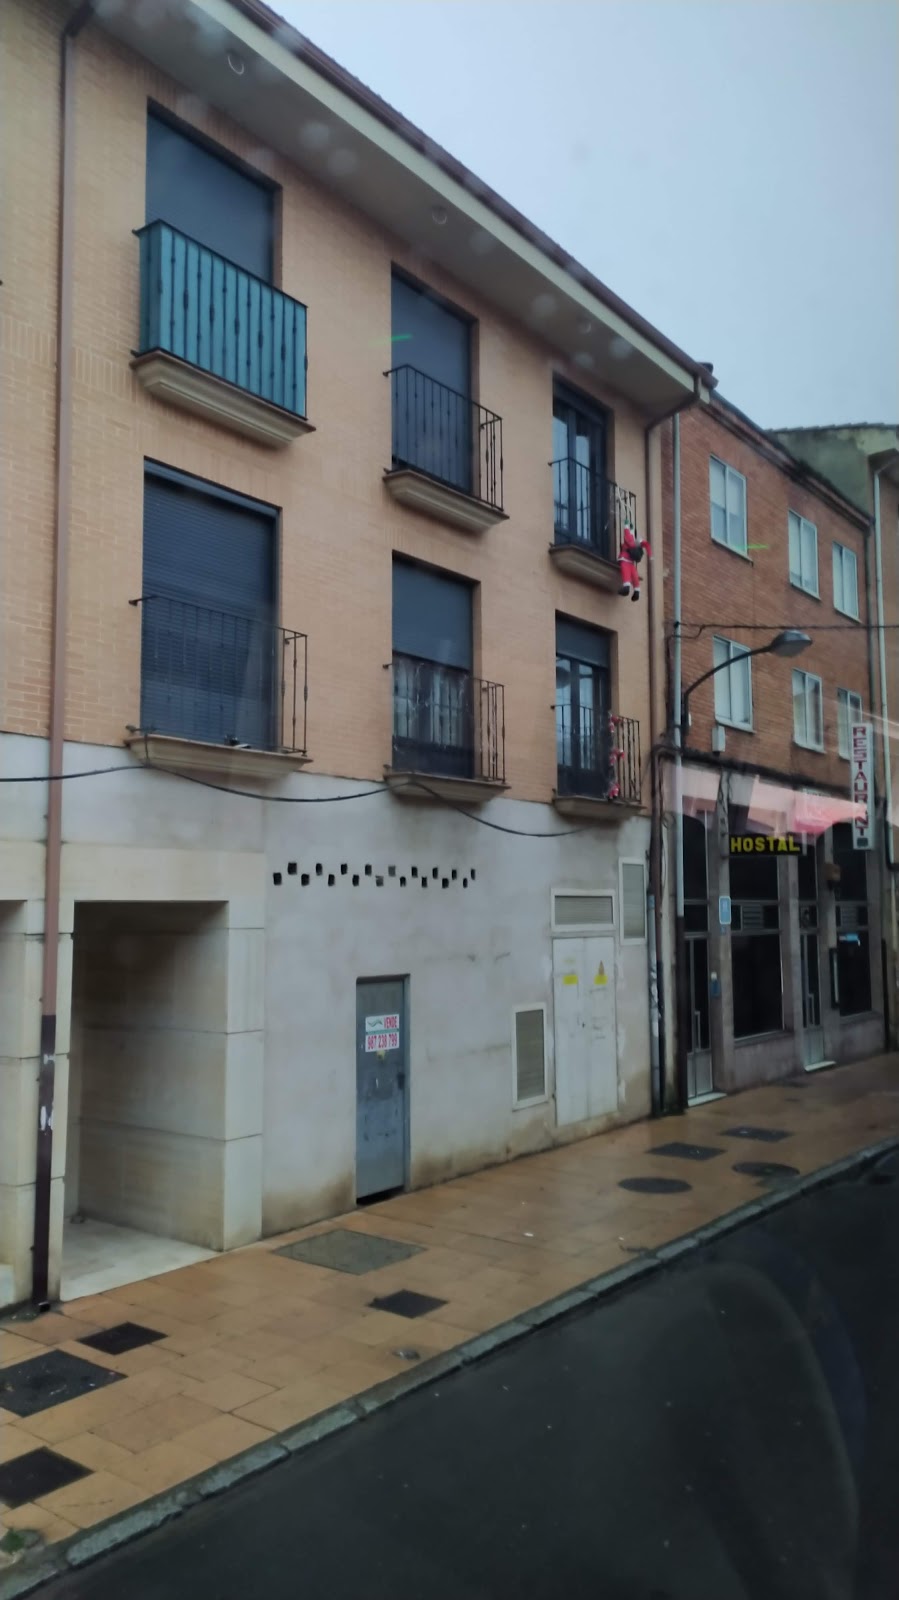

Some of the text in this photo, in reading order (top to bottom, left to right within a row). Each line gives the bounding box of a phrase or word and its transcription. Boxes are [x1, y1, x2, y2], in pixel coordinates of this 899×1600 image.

[853, 726, 868, 836] RESTAURNT
[731, 835, 800, 852] HOSTAL
[383, 1016, 397, 1029] VENDE
[368, 1035, 377, 1050] 987
